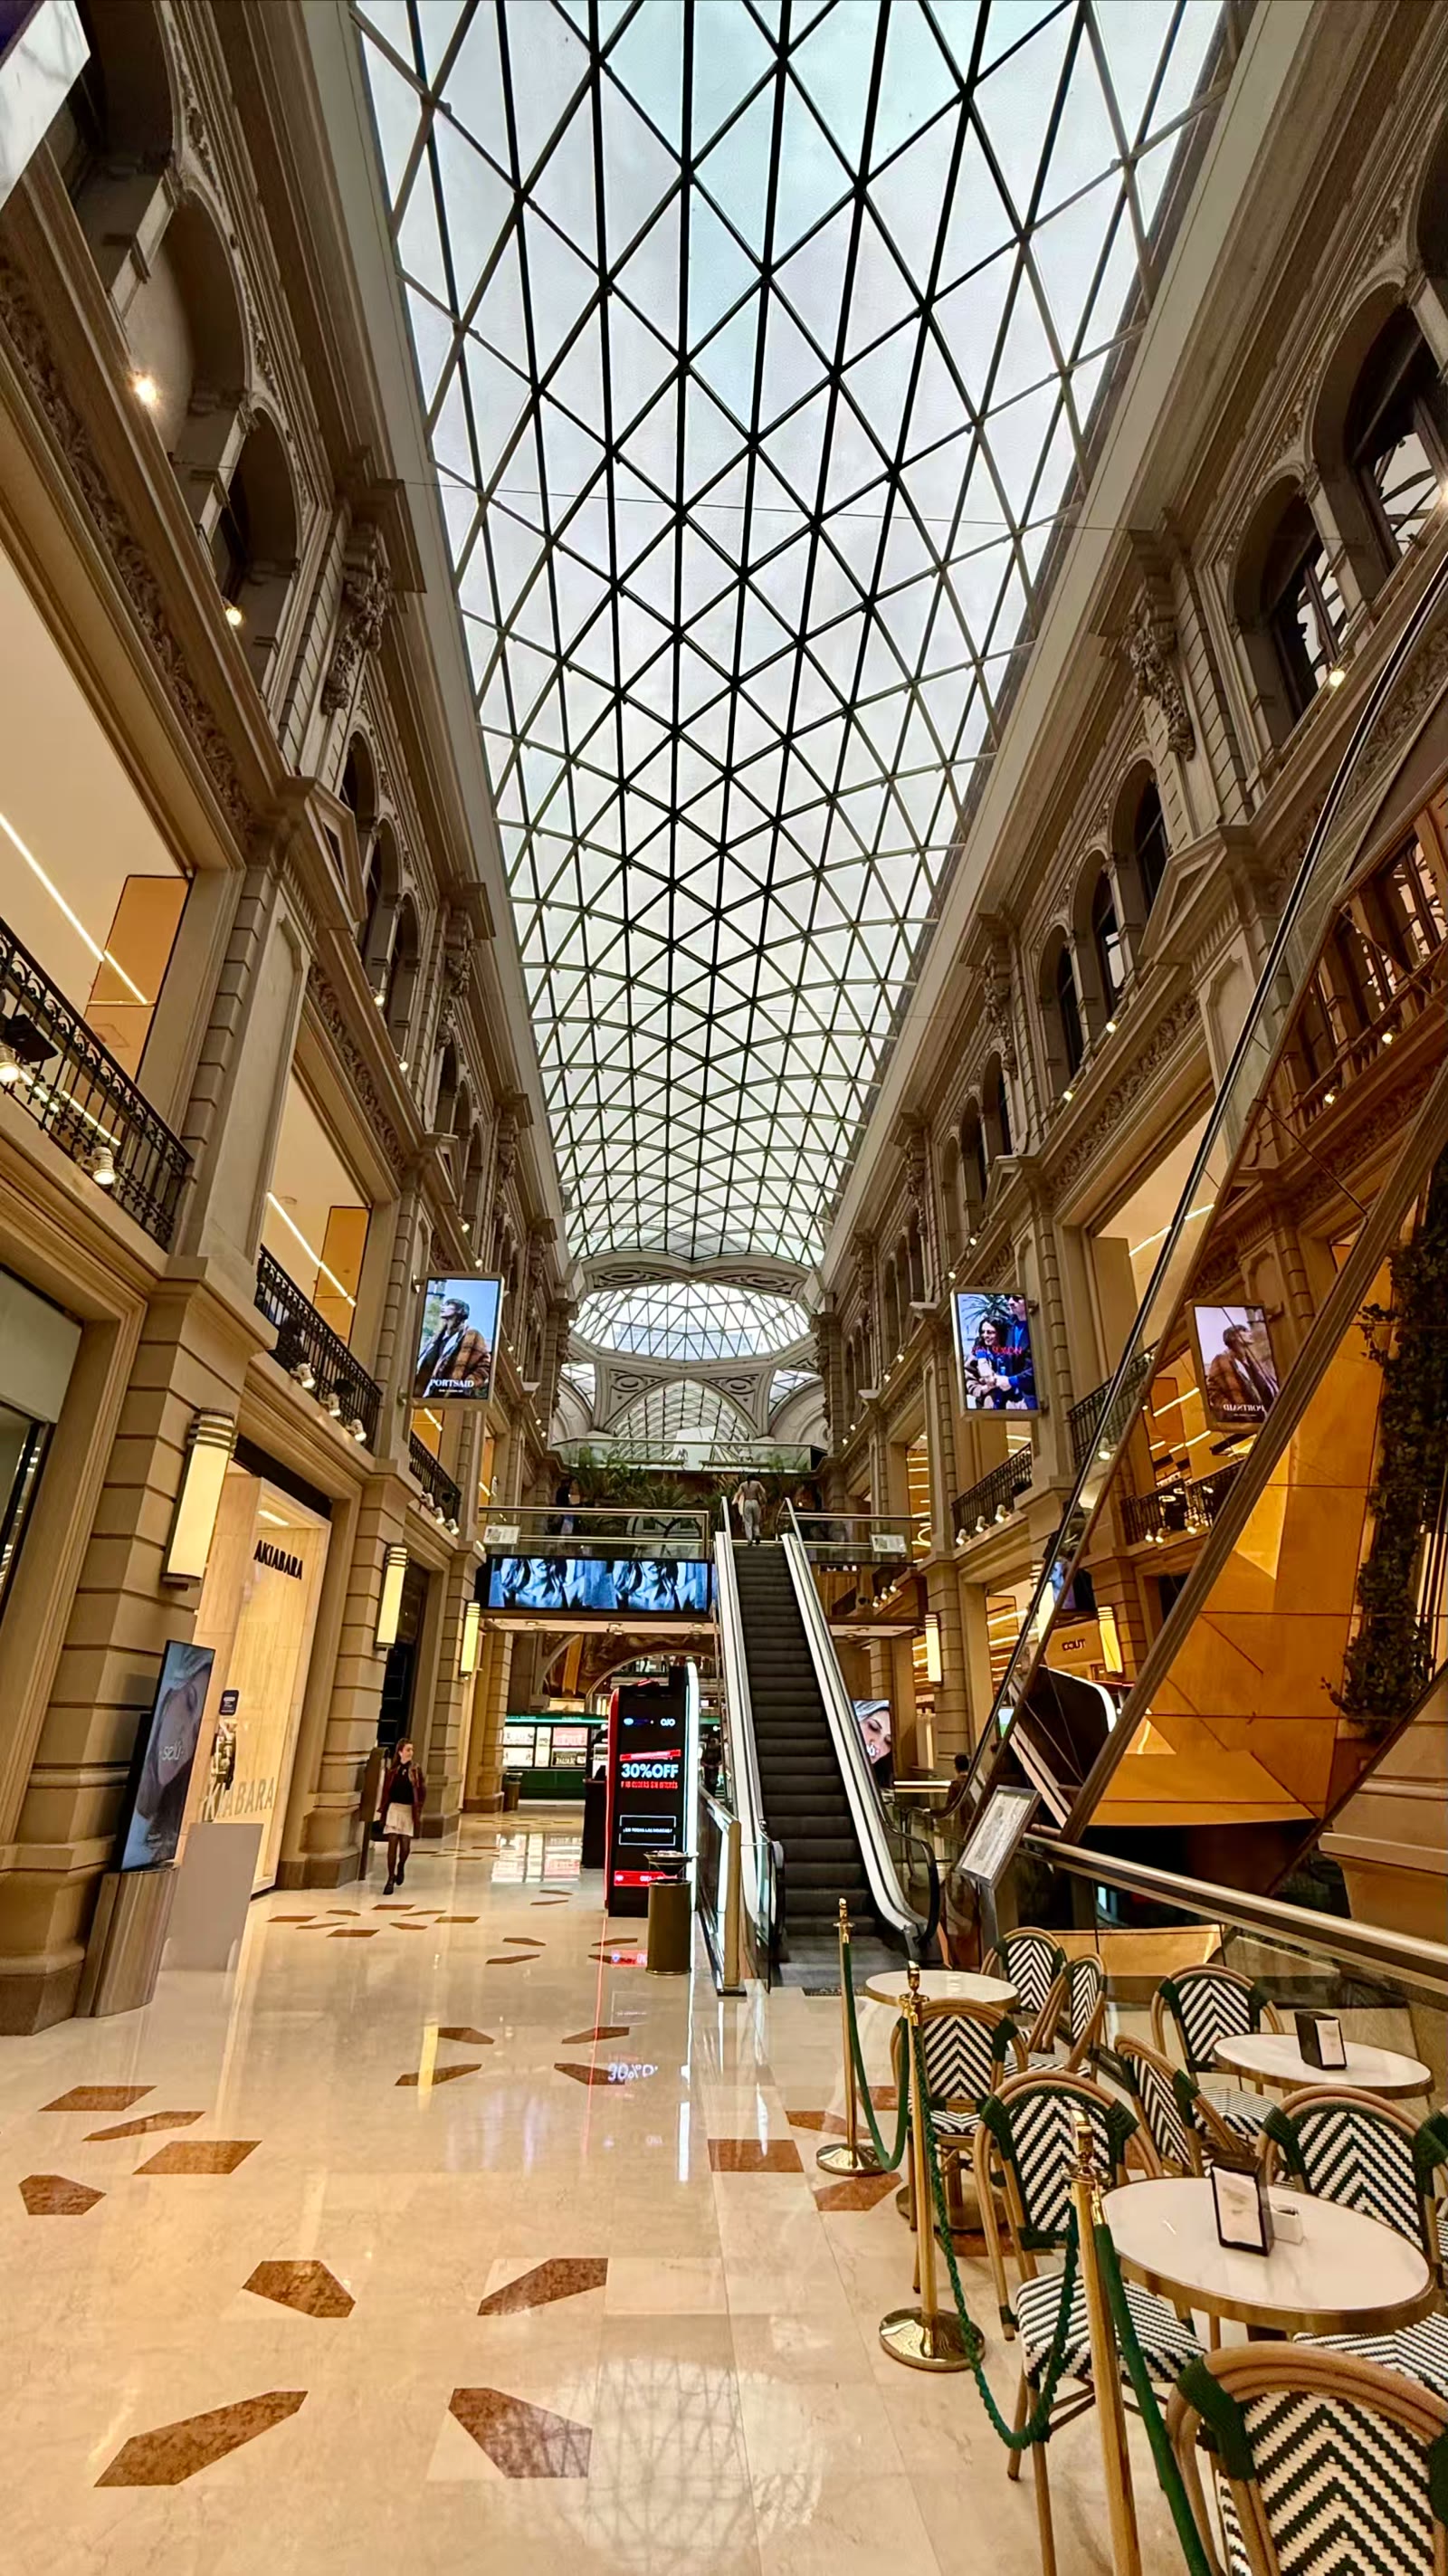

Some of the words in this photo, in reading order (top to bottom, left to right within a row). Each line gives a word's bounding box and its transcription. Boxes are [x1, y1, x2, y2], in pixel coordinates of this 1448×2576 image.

[430, 1379, 475, 1388] PORTSAID
[253, 1540, 303, 1580] AKIABARA
[621, 1763, 679, 1779] 30%OFF
